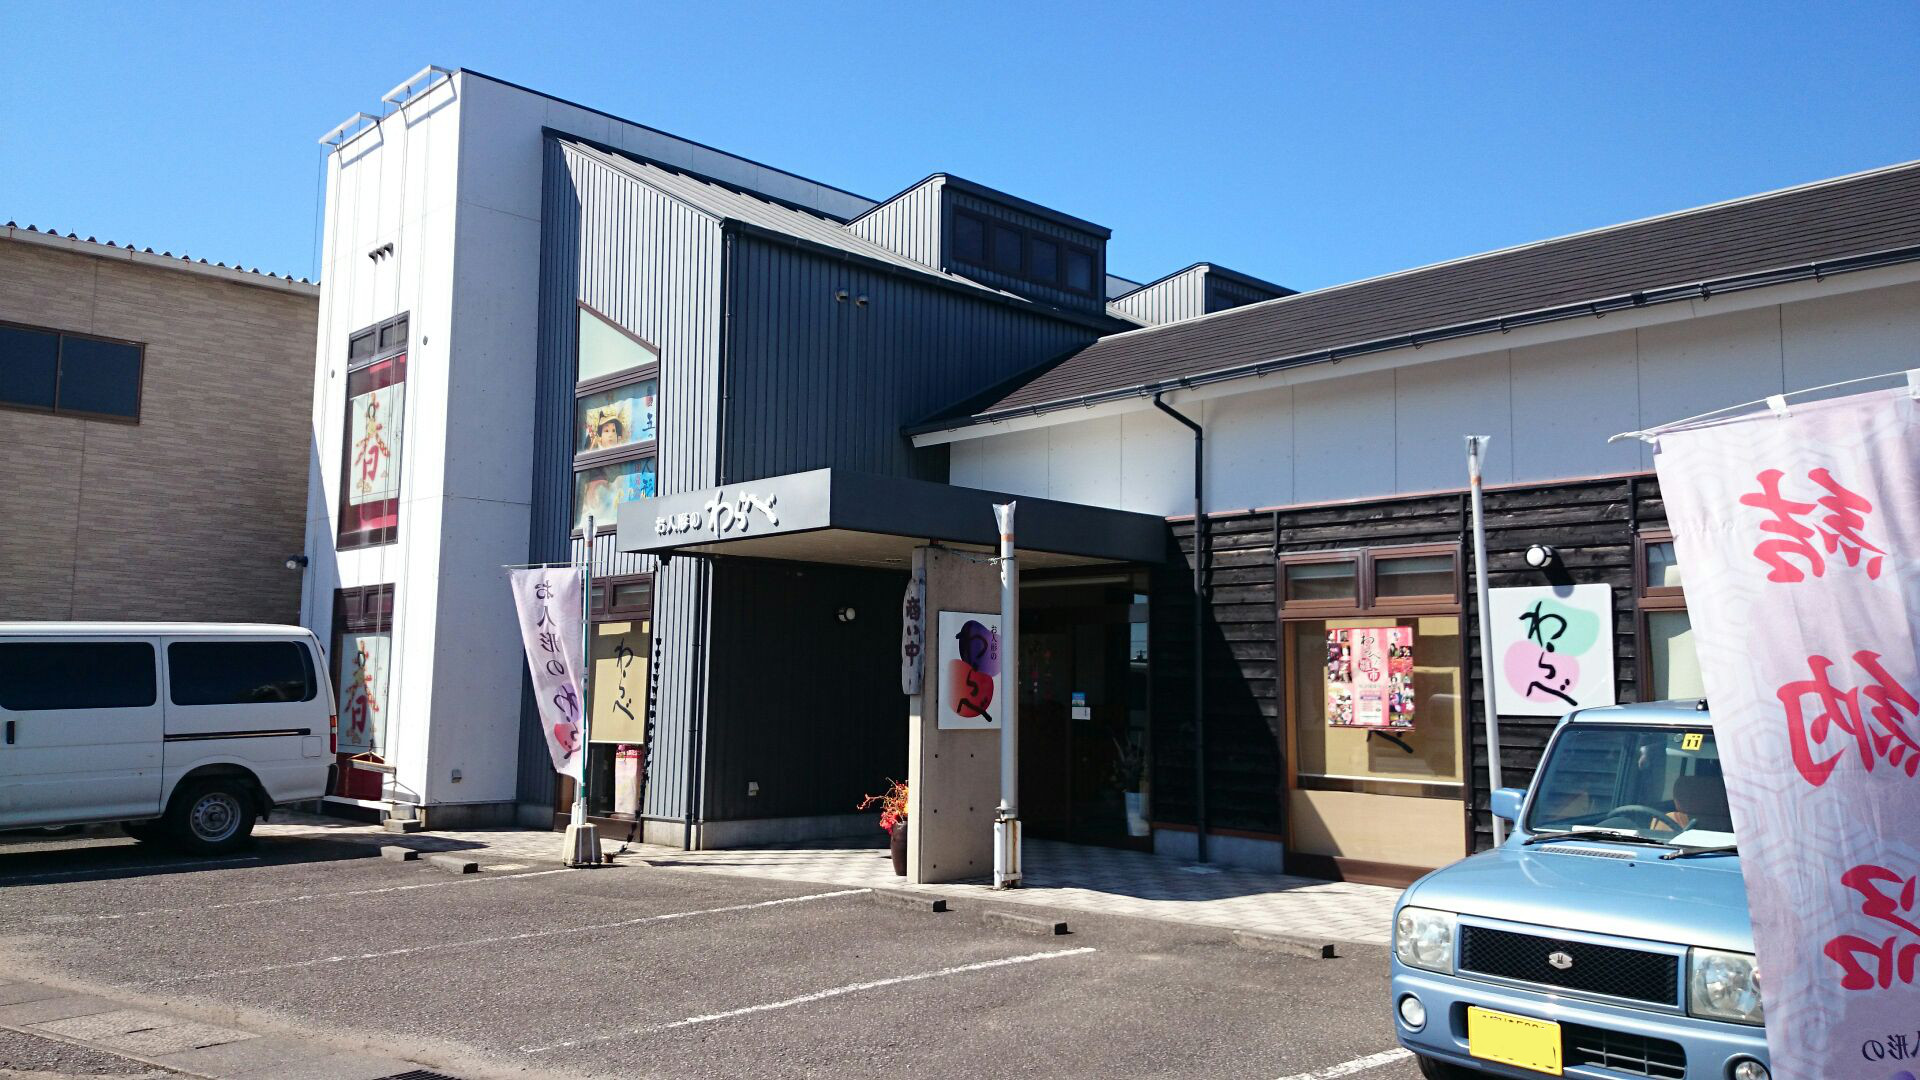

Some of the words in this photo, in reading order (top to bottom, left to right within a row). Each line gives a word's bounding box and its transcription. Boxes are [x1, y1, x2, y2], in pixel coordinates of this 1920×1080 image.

[654, 510, 702, 536] お人形の
[704, 489, 779, 539] わらべ
[904, 597, 921, 667] 商い中
[990, 624, 998, 661] お人形の
[1519, 600, 1578, 707] わらべ
[612, 636, 635, 721] わらべ
[954, 620, 994, 723] わらべ
